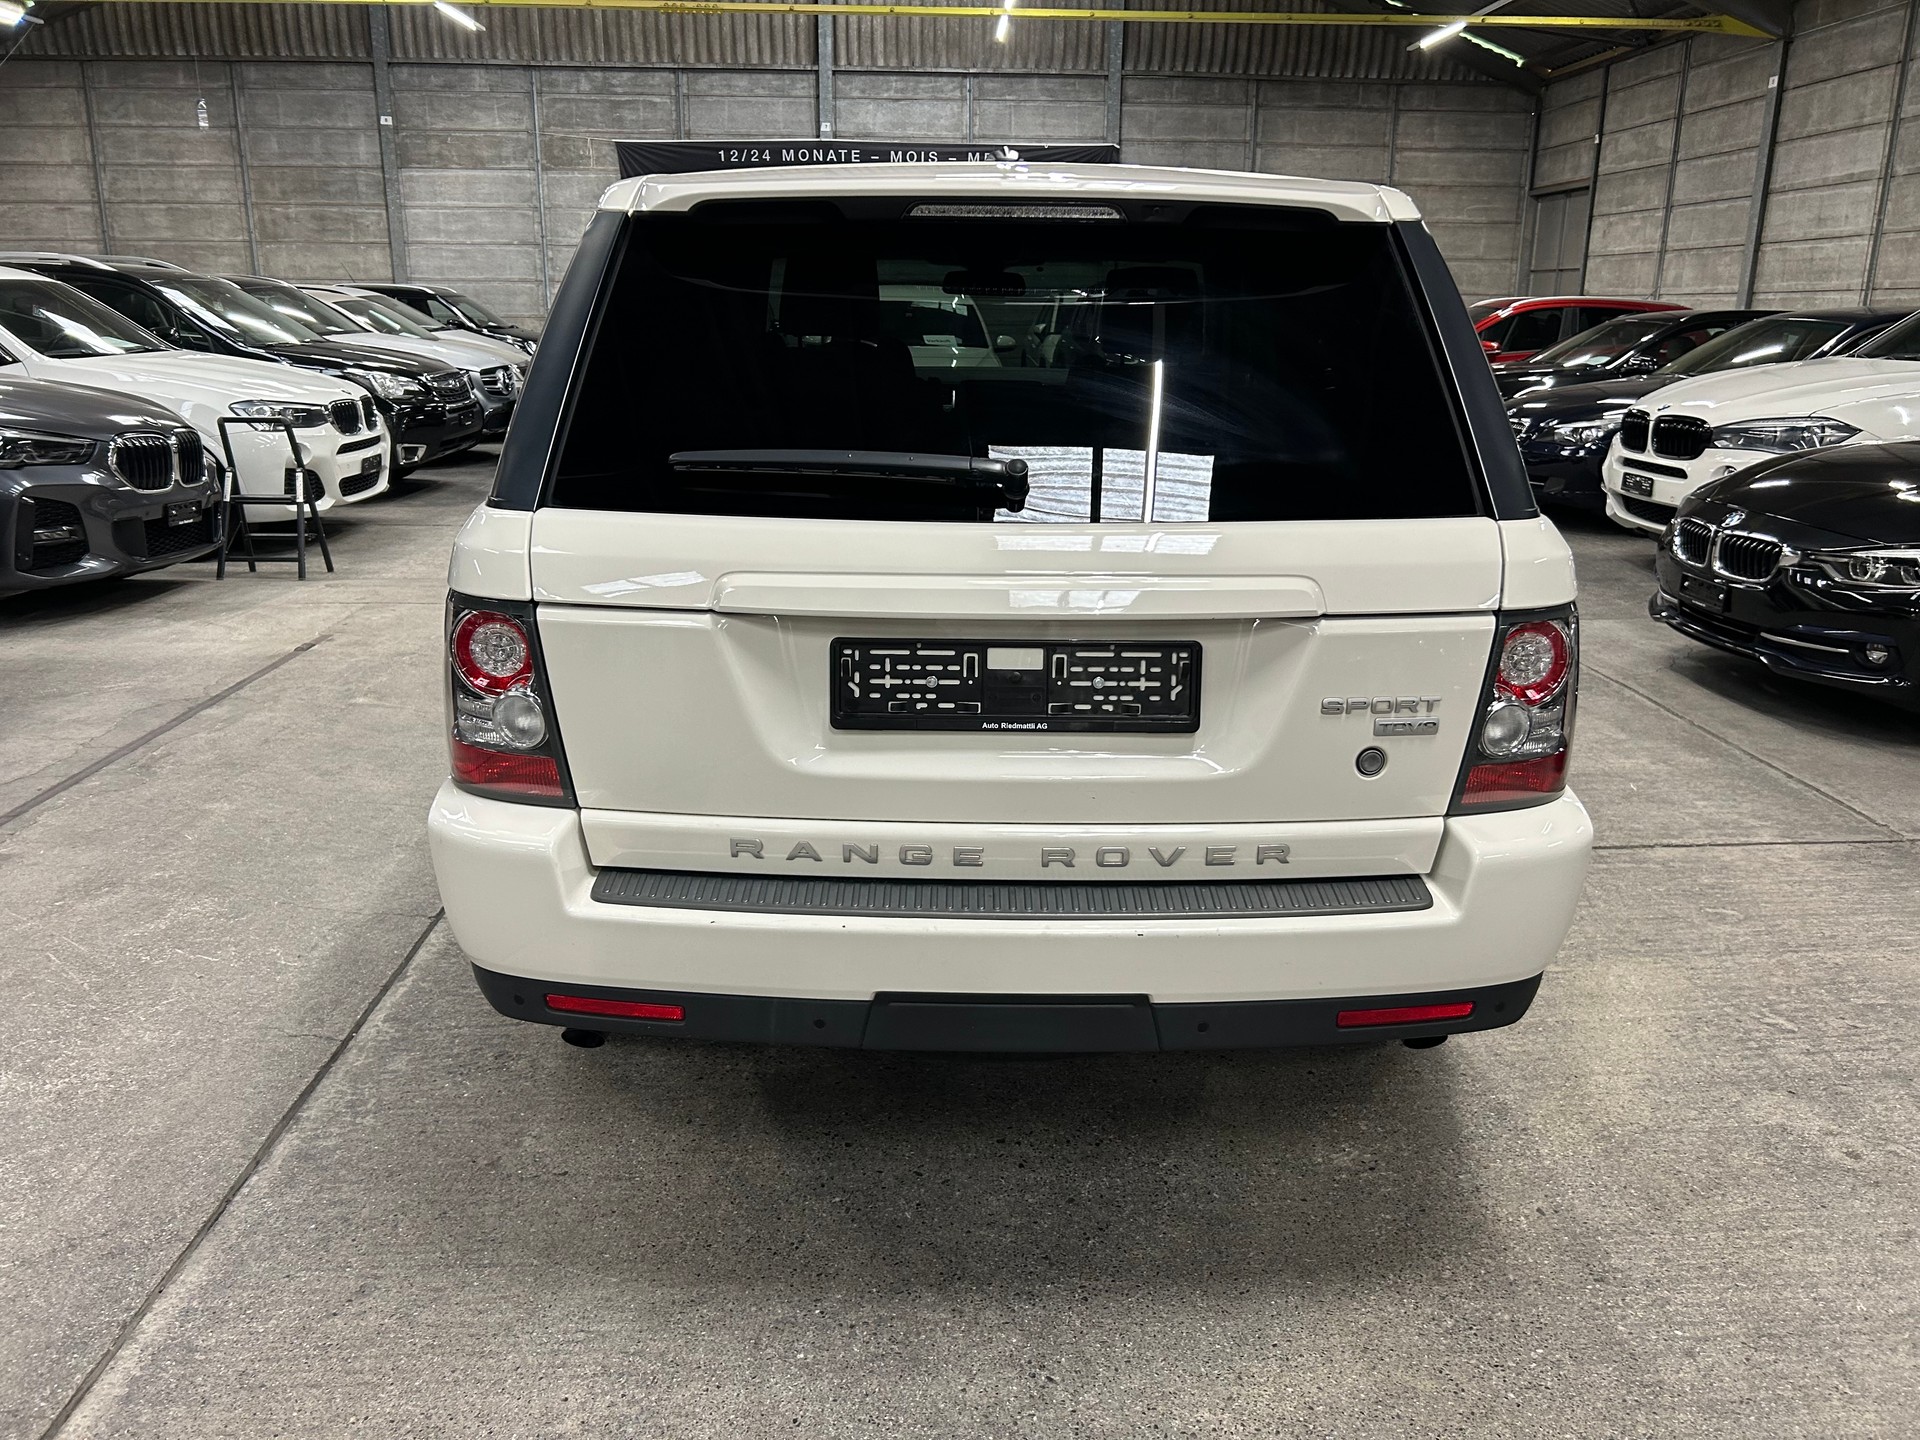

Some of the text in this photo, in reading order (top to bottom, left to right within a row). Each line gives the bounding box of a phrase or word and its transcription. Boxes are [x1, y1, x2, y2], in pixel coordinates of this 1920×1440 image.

[718, 149, 771, 162] 12/24
[782, 149, 861, 162] MONATE
[890, 150, 938, 163] MOIS
[1320, 696, 1442, 715] SPORT
[1036, 722, 1048, 730] AG
[729, 837, 1291, 868] RANGE ROVER
